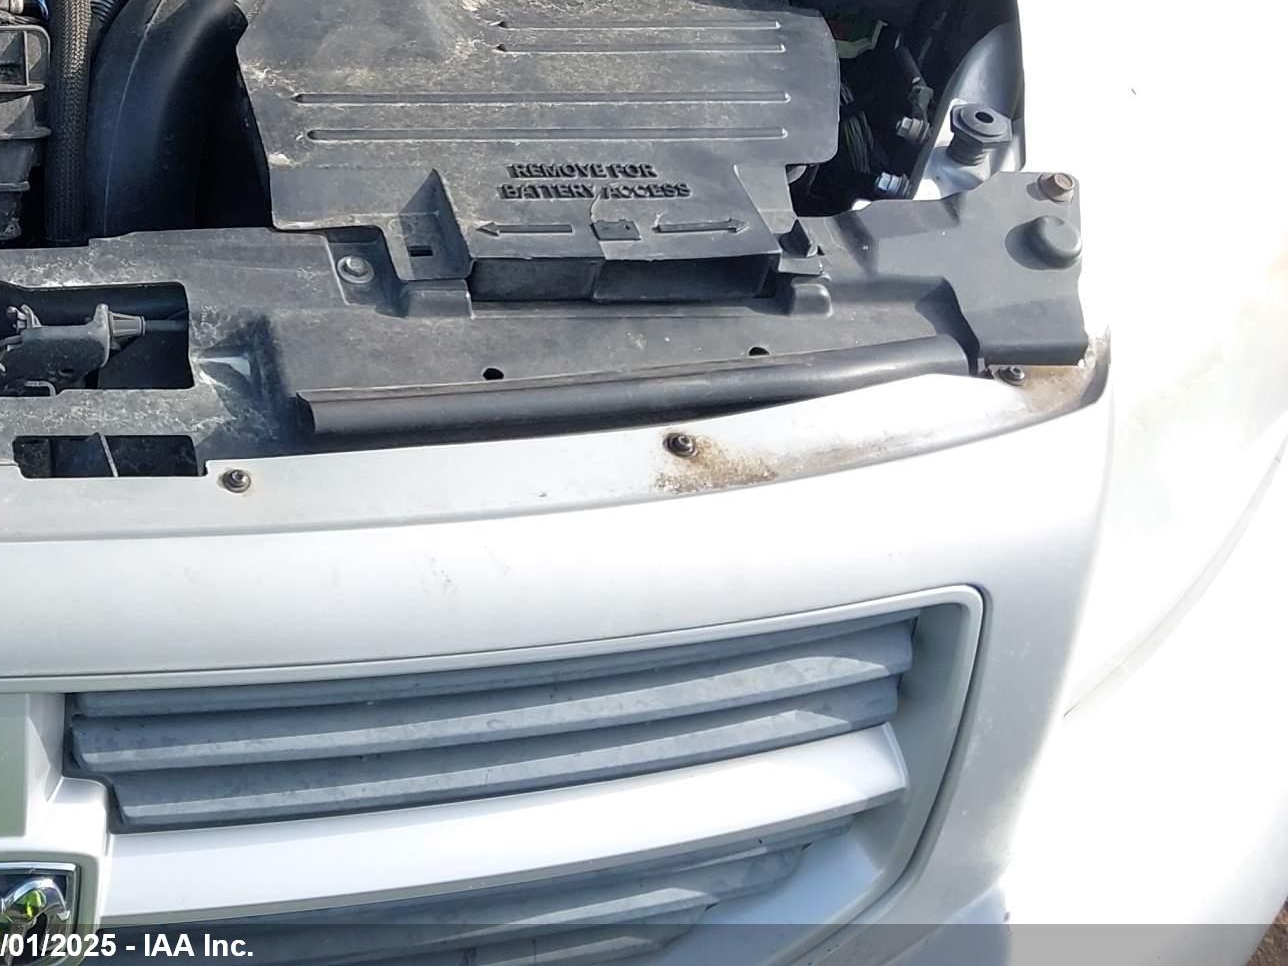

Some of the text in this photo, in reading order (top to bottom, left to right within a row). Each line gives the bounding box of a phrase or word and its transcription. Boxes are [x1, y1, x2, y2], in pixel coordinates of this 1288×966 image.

[506, 163, 658, 178] REMOVE FOR
[498, 183, 691, 199] BATTERY ACCESS
